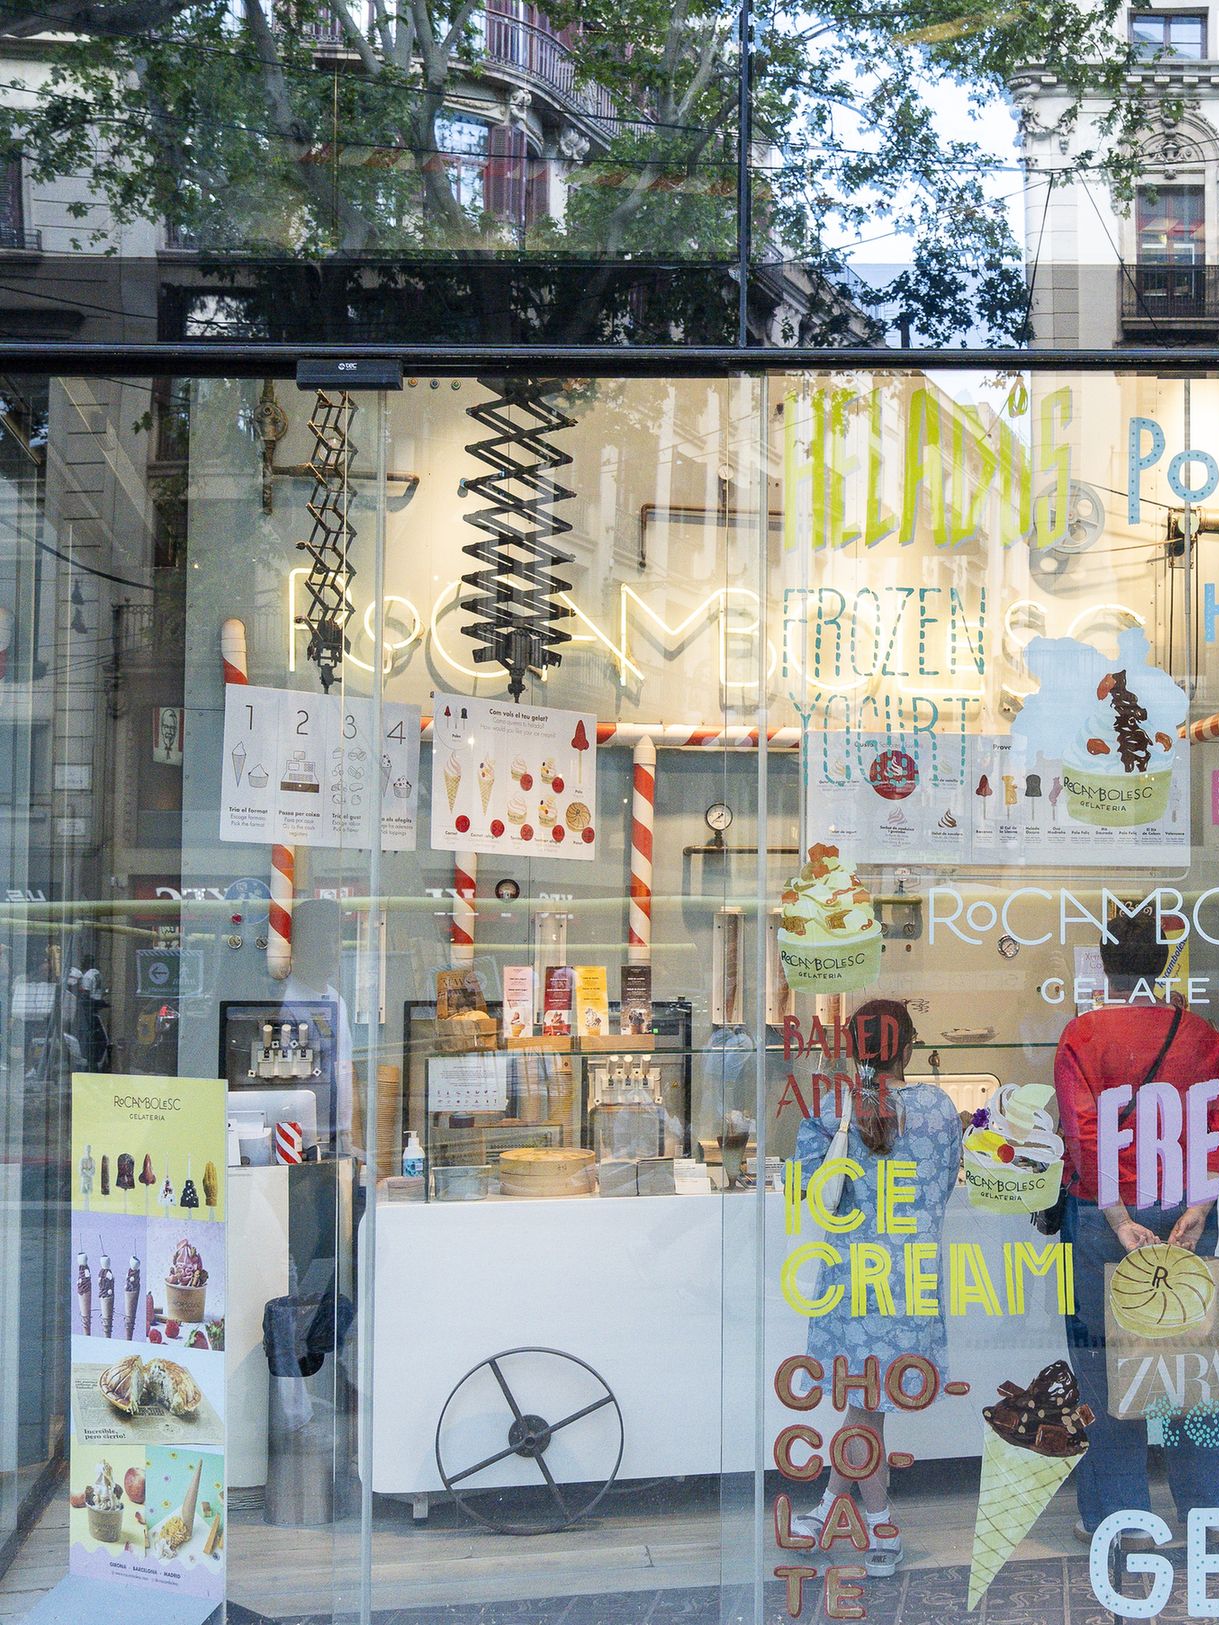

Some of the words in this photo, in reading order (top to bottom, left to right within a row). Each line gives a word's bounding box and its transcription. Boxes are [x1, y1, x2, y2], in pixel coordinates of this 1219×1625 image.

[783, 586, 985, 678] FROZEN
[245, 704, 254, 731] 1
[296, 709, 309, 736] 2
[343, 714, 357, 740] 3
[386, 720, 407, 745] 4
[1079, 800, 1127, 812] GELATERIA
[798, 971, 842, 980] GELATERIA
[783, 1013, 900, 1061] BAKED
[113, 1095, 182, 1111] ROCAMBOLESC
[776, 1073, 903, 1120] APPLE
[129, 1113, 166, 1121] GELATERIA
[785, 1156, 919, 1235] ICE
[980, 1191, 1022, 1201] GELATERIA
[780, 1241, 1076, 1317] CREAM
[774, 1354, 971, 1412] CHO-
[774, 1424, 915, 1481] CO-
[775, 1492, 898, 1552] LA-
[109, 1561, 127, 1569] GIRONA
[132, 1566, 158, 1575] BARCELONA
[163, 1571, 181, 1579] MADRID
[871, 1554, 887, 1563] NIKE
[773, 1564, 867, 1619] TE
